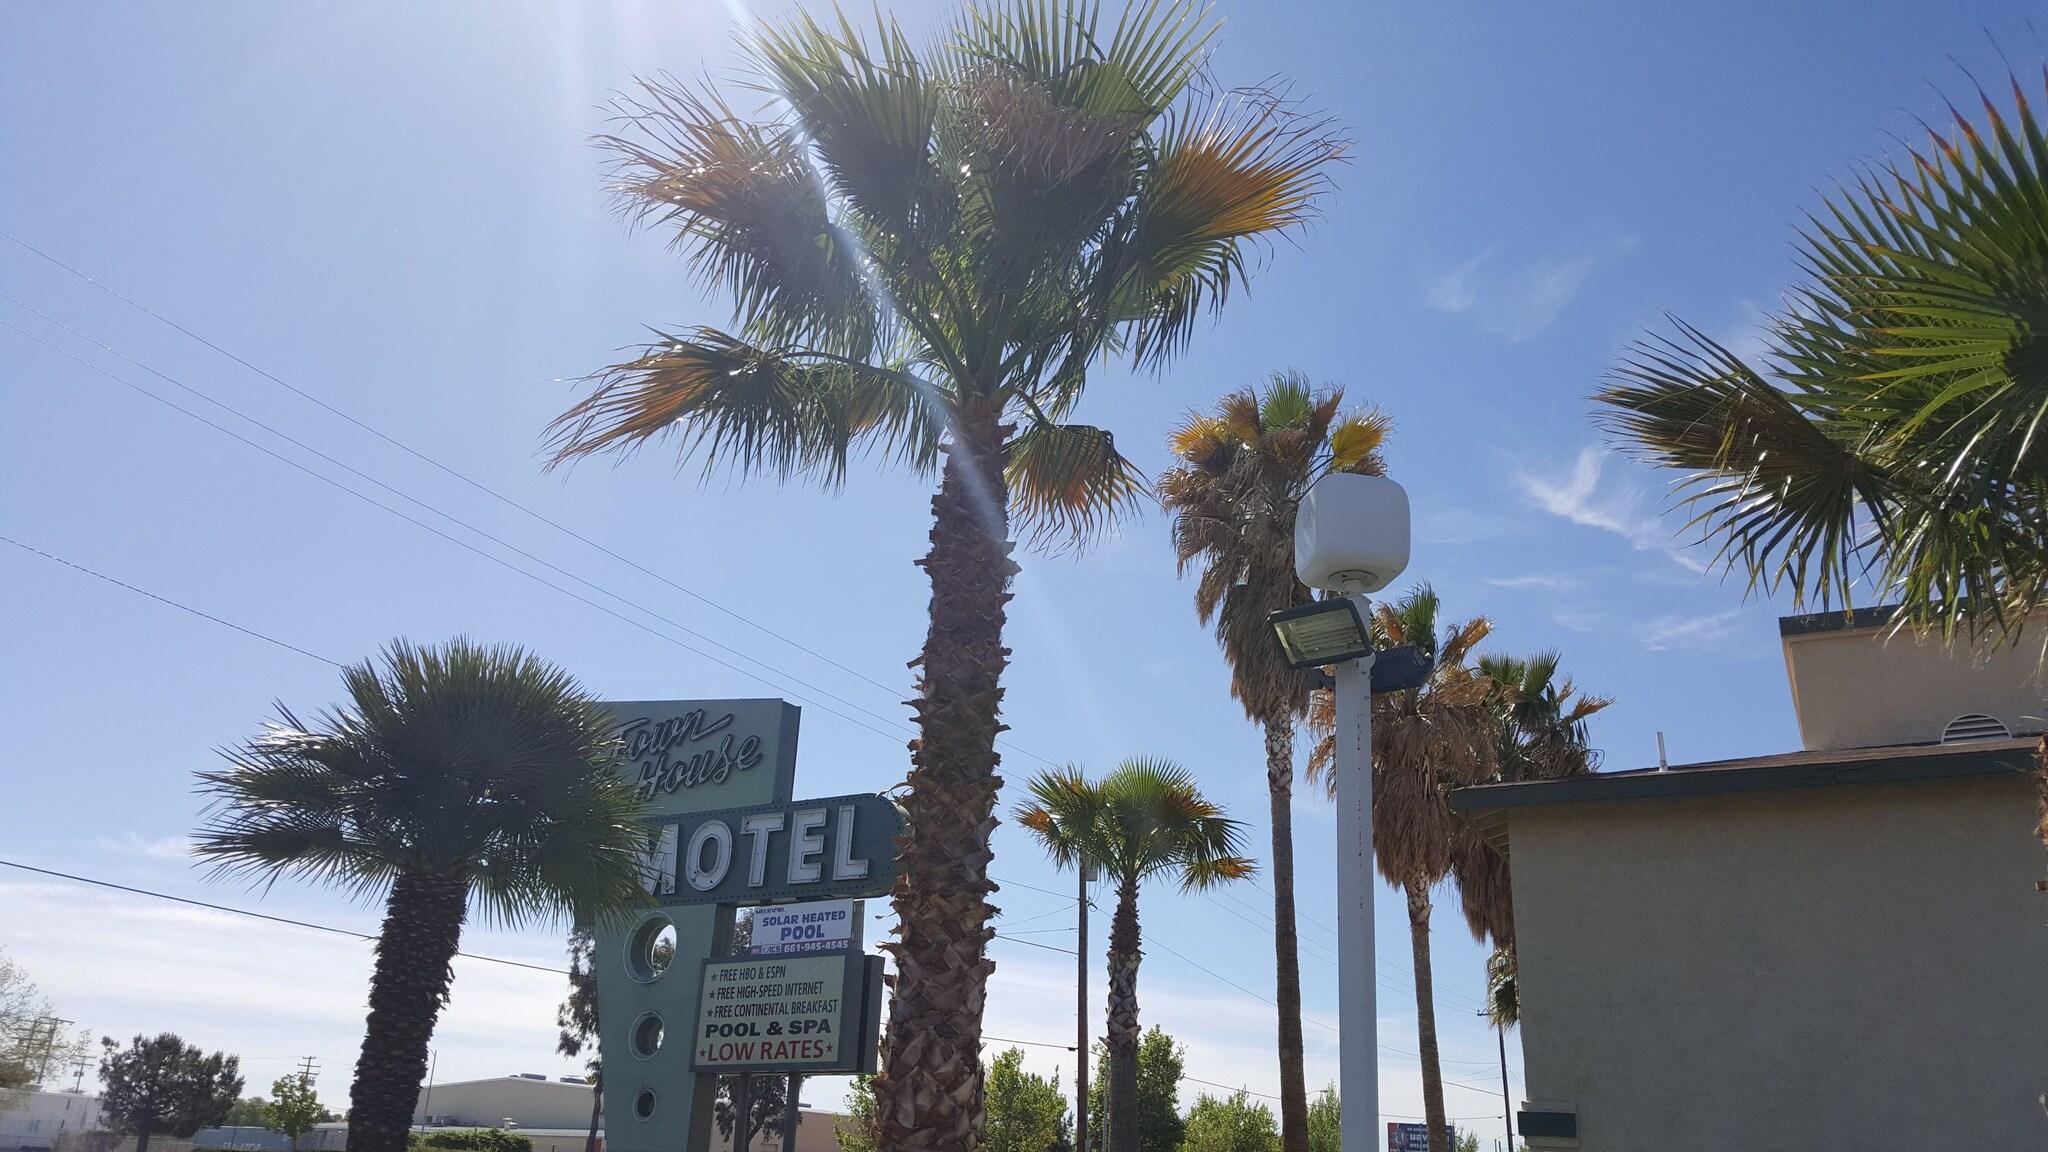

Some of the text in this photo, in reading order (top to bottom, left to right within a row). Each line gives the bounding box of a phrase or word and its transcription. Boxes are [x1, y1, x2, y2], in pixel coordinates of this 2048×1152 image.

[610, 708, 734, 762] Town
[632, 733, 763, 801] House
[631, 805, 868, 895] MOTEL
[763, 910, 846, 927] SOLAR HEATED
[780, 924, 825, 941] POOL
[720, 965, 786, 982] FREE HBO & ESPN
[717, 981, 824, 1000] FREE HIGH-SPEED INTERNET
[714, 1000, 838, 1018] FREE CONTINENTAL BREAKFAST
[705, 1018, 831, 1038] POOL & SPA
[708, 1039, 824, 1062] LOW RATES
